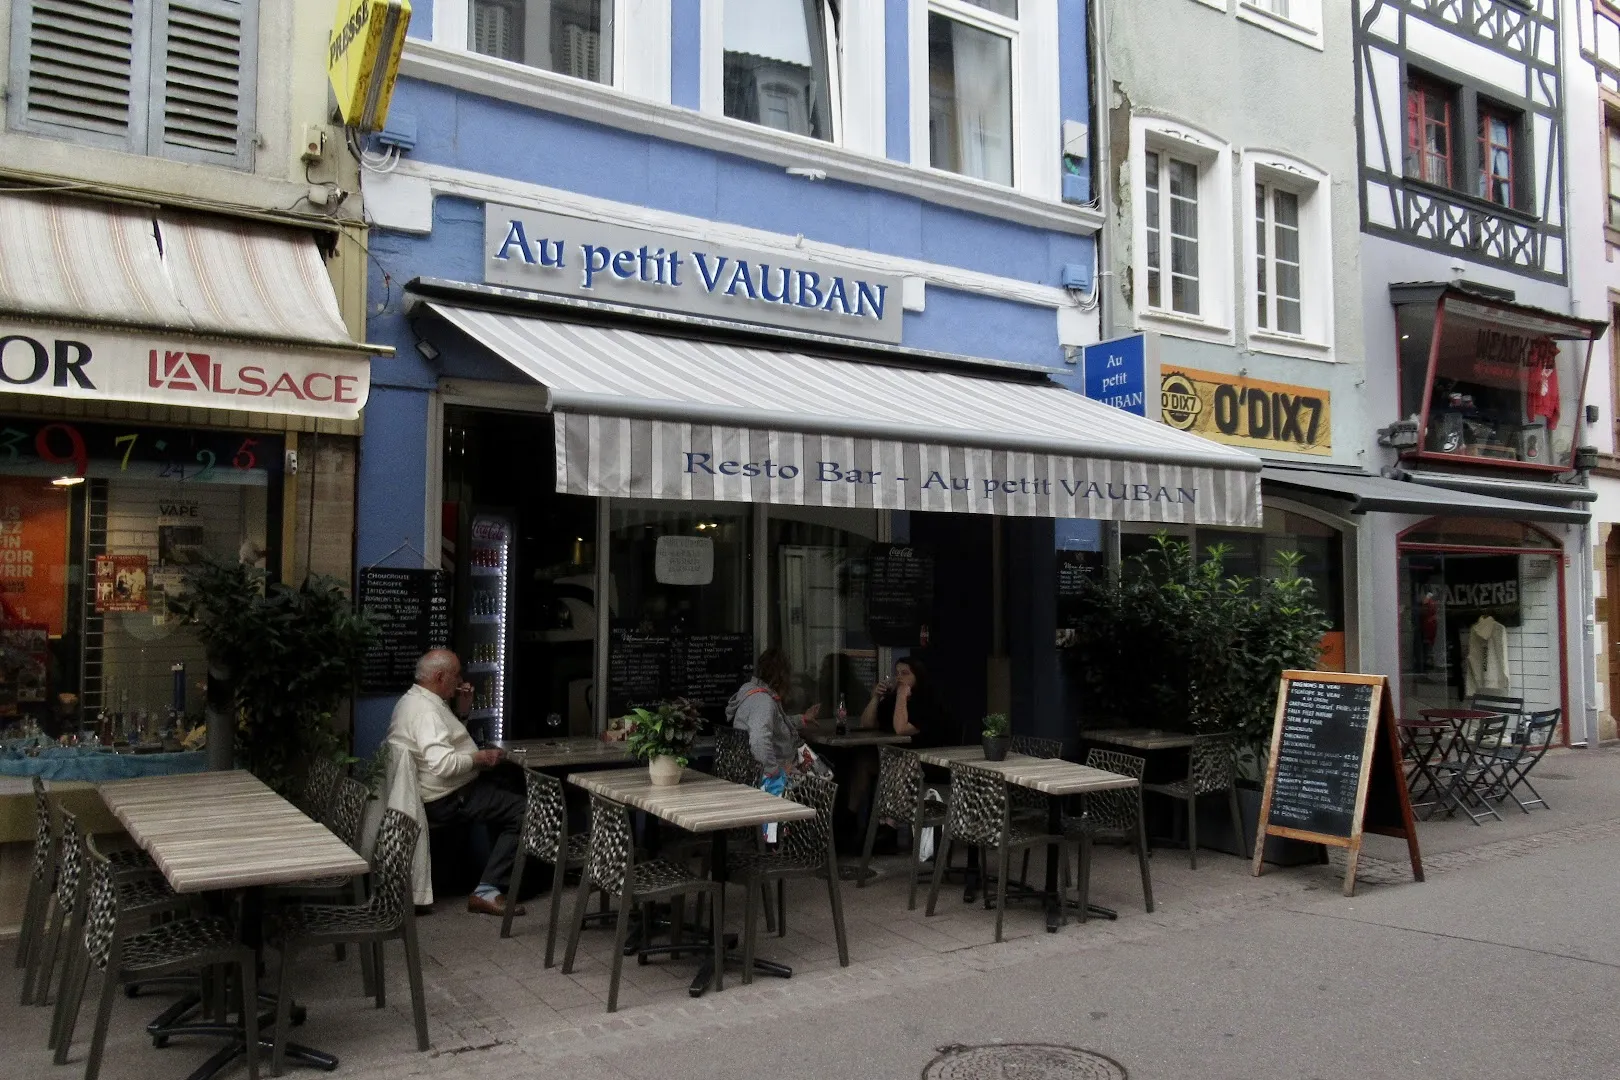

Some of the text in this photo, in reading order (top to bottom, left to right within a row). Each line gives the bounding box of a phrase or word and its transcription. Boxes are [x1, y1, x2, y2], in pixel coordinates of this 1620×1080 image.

[330, 0, 369, 70] PRESSE
[494, 220, 888, 320] Au petit VAUBAN
[1106, 355, 1123, 368] Au
[1102, 372, 1127, 392] petit
[1096, 391, 1143, 409] UBAN
[1161, 393, 1196, 411] O'DIX7
[1214, 383, 1322, 445] O'DIX7
[683, 452, 799, 479] Resto
[815, 461, 882, 484] Bar
[920, 471, 971, 491] Au
[984, 478, 1052, 498] petit
[1058, 479, 1199, 503] VAUBAN
[160, 505, 199, 517] VAPE
